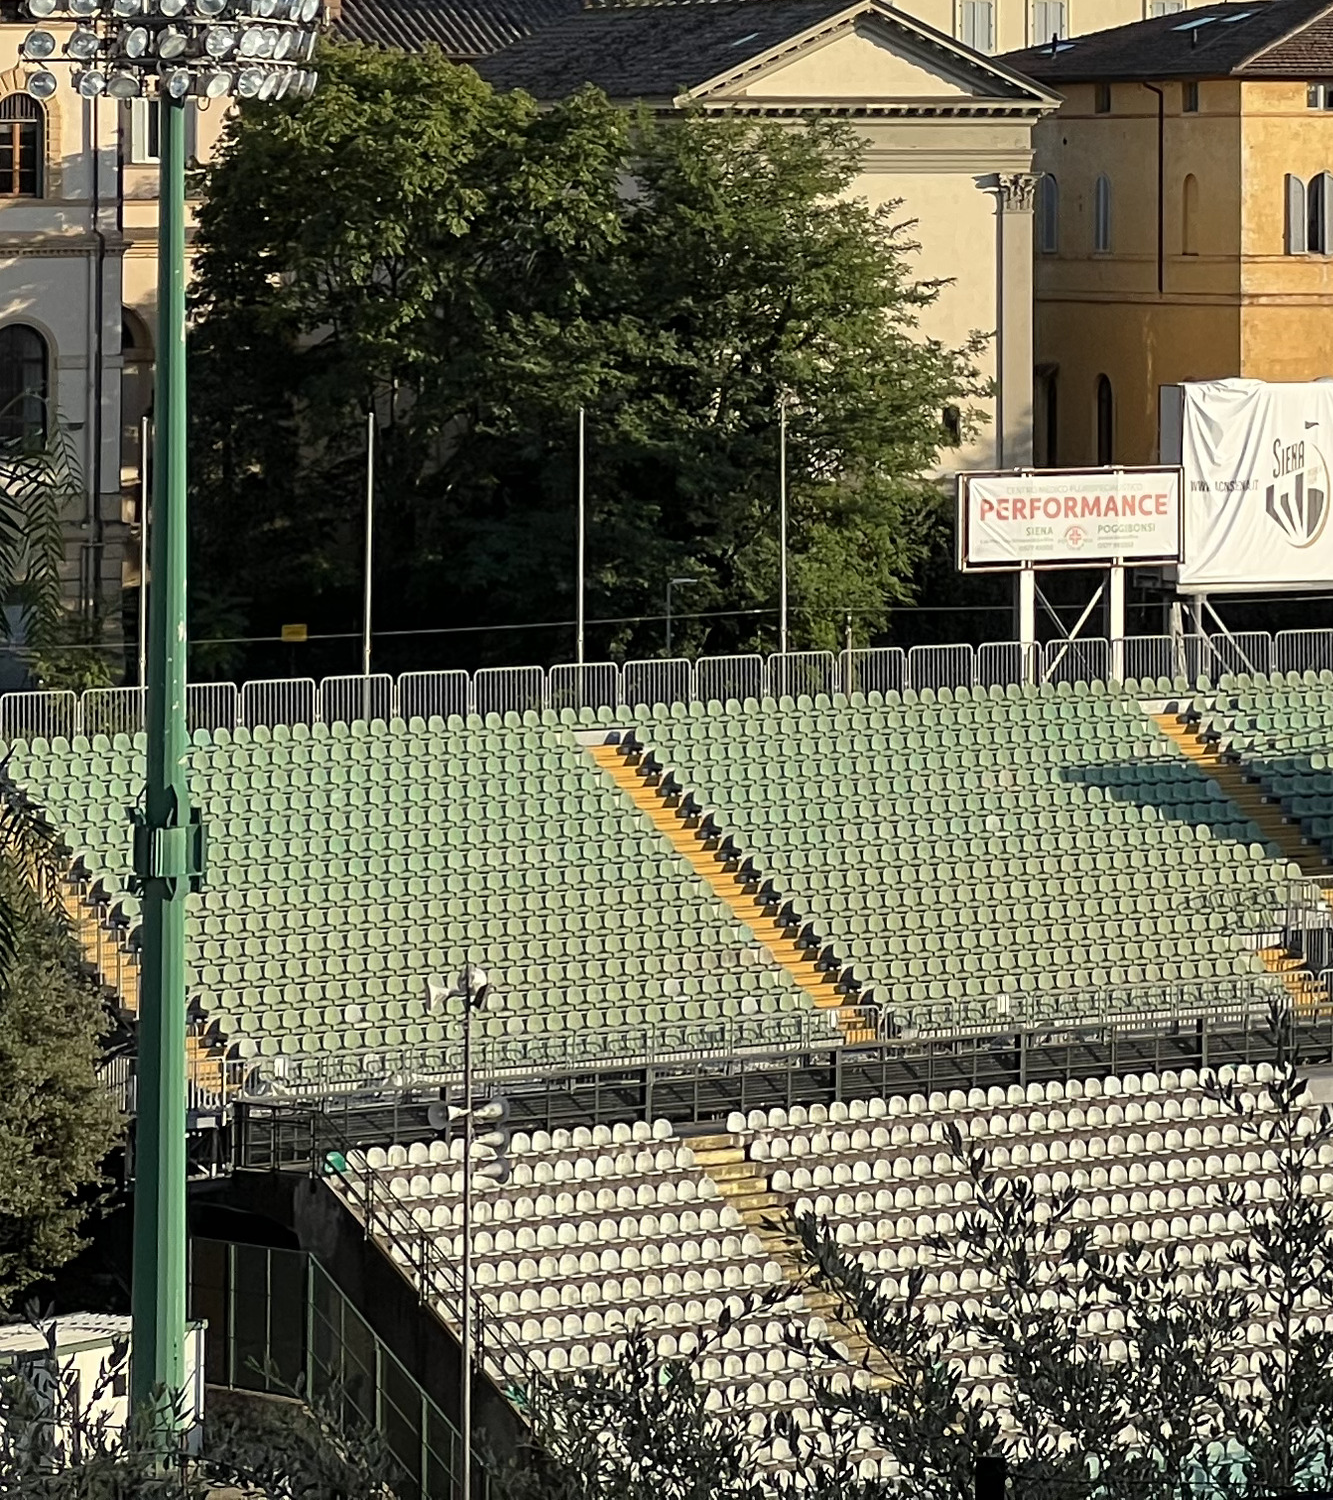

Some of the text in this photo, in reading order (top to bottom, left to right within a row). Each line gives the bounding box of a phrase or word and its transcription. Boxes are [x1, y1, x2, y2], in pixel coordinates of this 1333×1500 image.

[1272, 438, 1305, 479] SIENA
[980, 493, 1168, 521] PERFORMANCE
[1026, 526, 1054, 536] SIENA
[1097, 522, 1156, 534] POGGIBONSI
